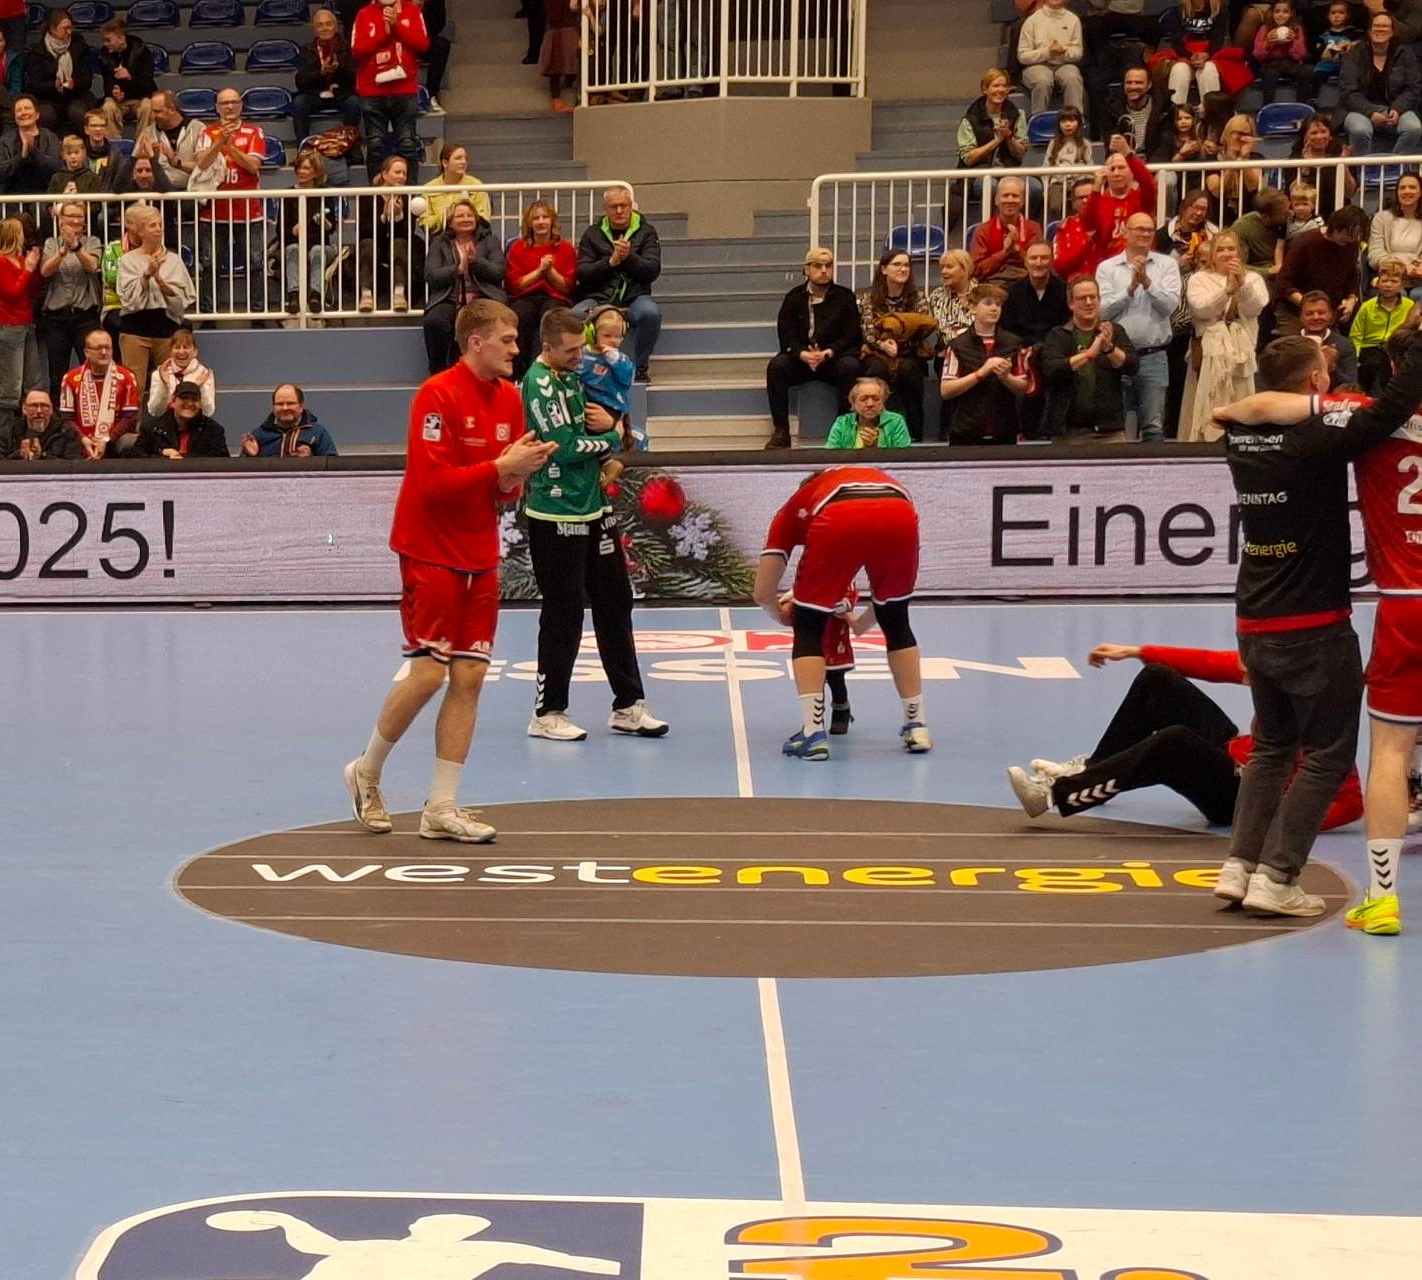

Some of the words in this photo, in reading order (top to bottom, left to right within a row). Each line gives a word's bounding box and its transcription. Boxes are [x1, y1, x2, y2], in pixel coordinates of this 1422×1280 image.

[1237, 491, 1288, 505] ENNTAG
[1243, 539, 1298, 559] energie
[251, 860, 1220, 893] westenergie
